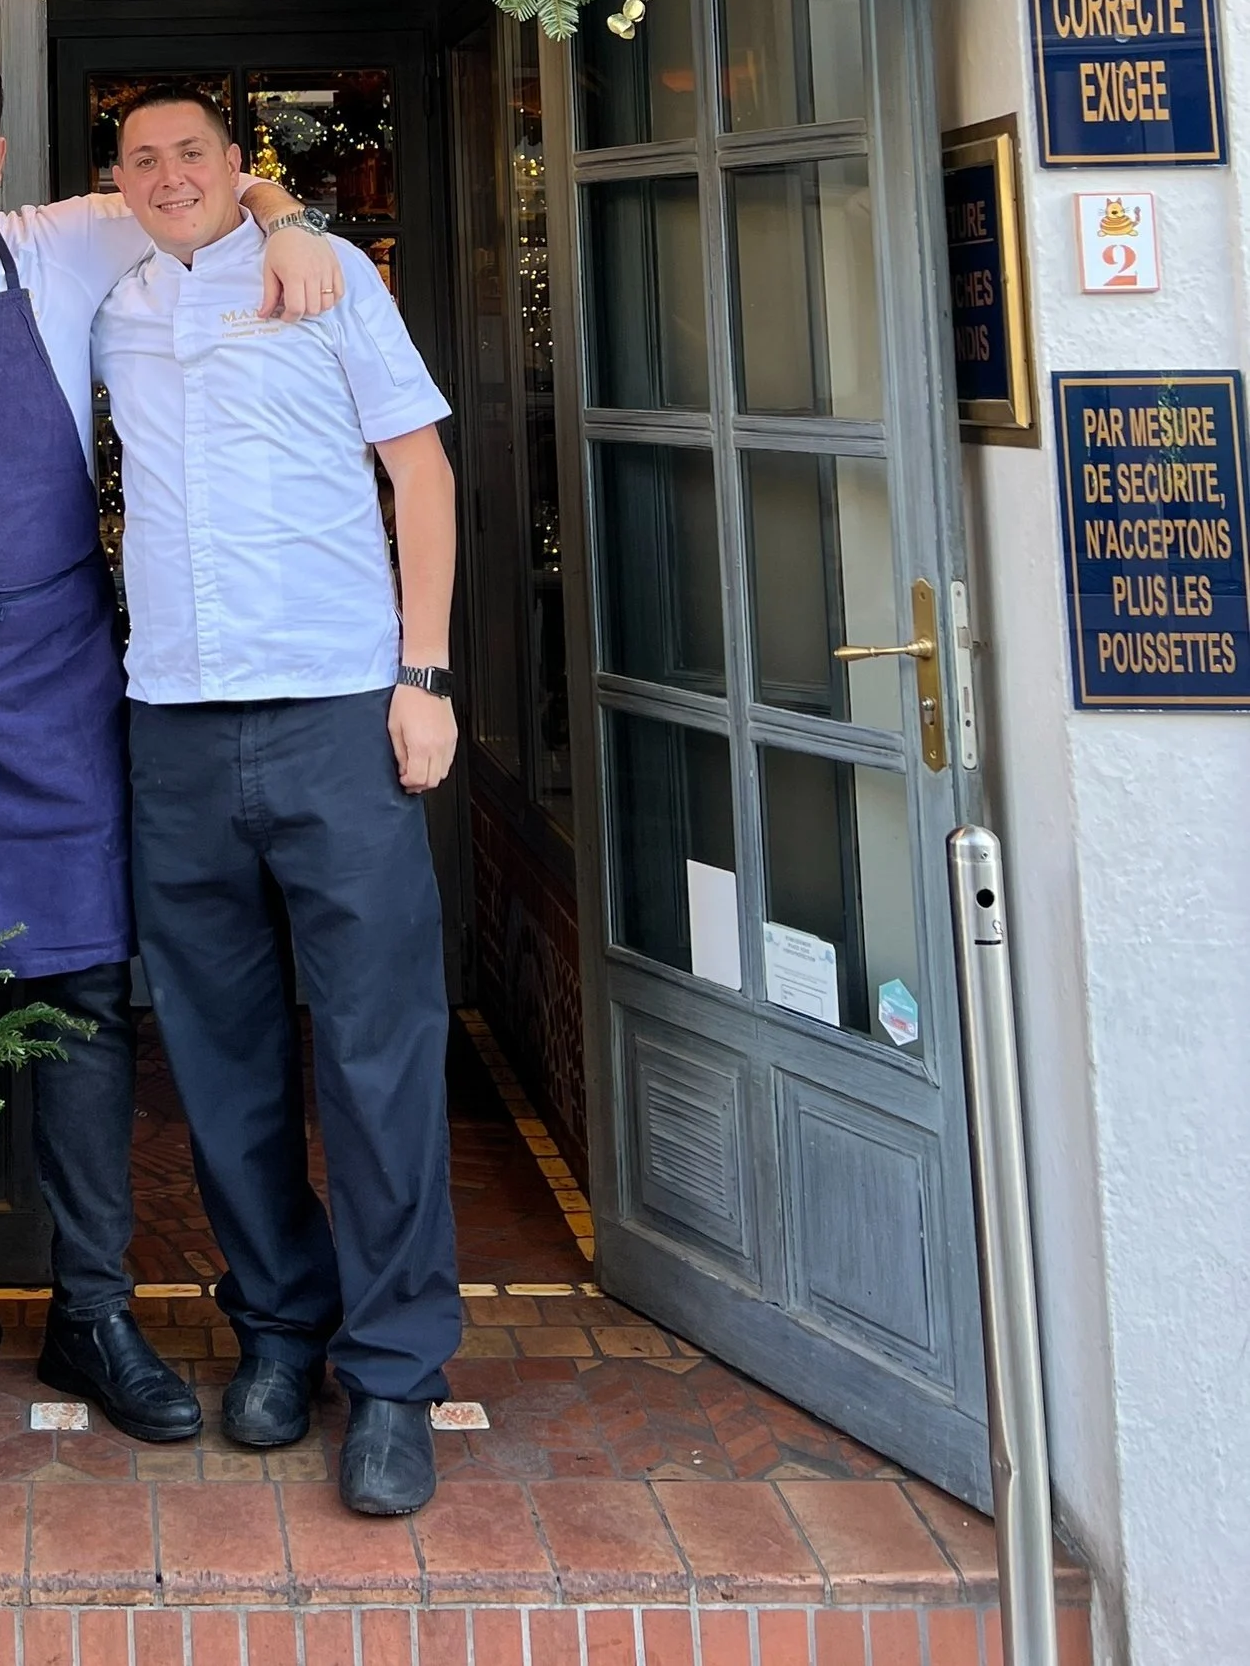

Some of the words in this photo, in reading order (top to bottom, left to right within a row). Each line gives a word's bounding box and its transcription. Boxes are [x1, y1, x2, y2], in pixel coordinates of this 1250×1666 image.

[1080, 60, 1169, 122] EXIGEE
[1102, 244, 1138, 286] 2
[1083, 407, 1126, 447] PAR
[1129, 407, 1217, 447] MESURE
[1083, 464, 1115, 503] DE
[1117, 463, 1226, 510] SECURITE,
[1085, 519, 1232, 560] N'ACCEPTONS
[1112, 575, 1167, 617] PLUS
[1172, 575, 1213, 616] LES
[1099, 632, 1236, 674] POUSSETTES
